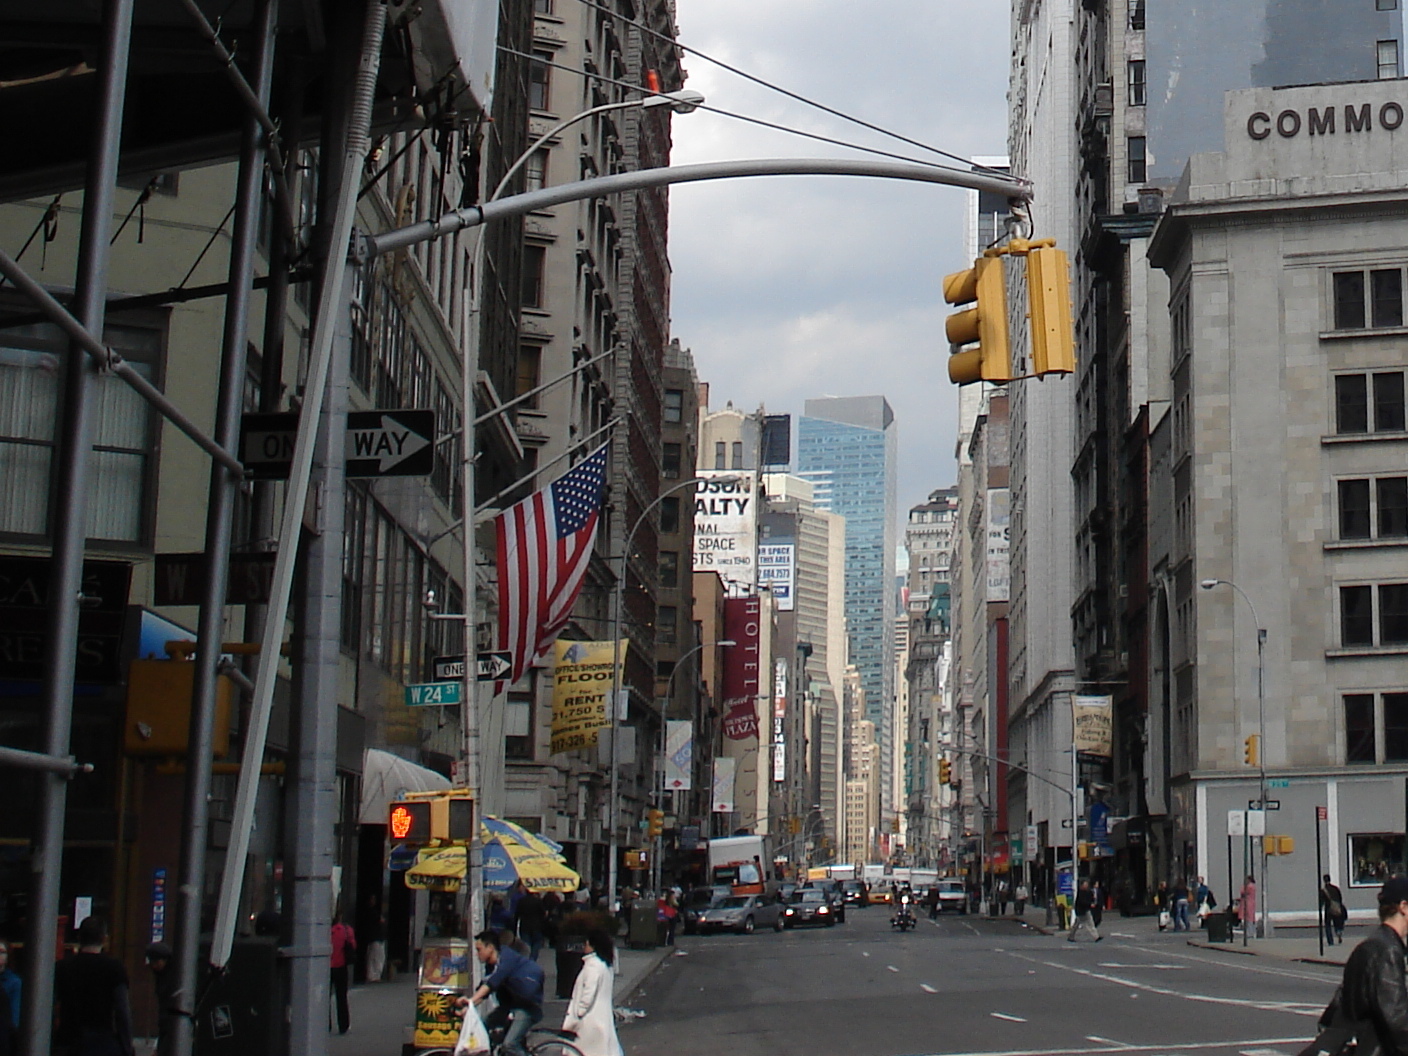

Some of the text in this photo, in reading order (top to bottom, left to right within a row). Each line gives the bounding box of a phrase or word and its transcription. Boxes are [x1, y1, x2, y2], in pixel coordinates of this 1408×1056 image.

[262, 431, 410, 459] ON WAY
[698, 538, 736, 551] SPACE
[743, 601, 759, 689] HOTEL
[443, 659, 503, 676] ONE WAY
[410, 684, 456, 704] W 24 ST
[564, 695, 606, 708] RENT
[726, 722, 757, 737] PLAZA
